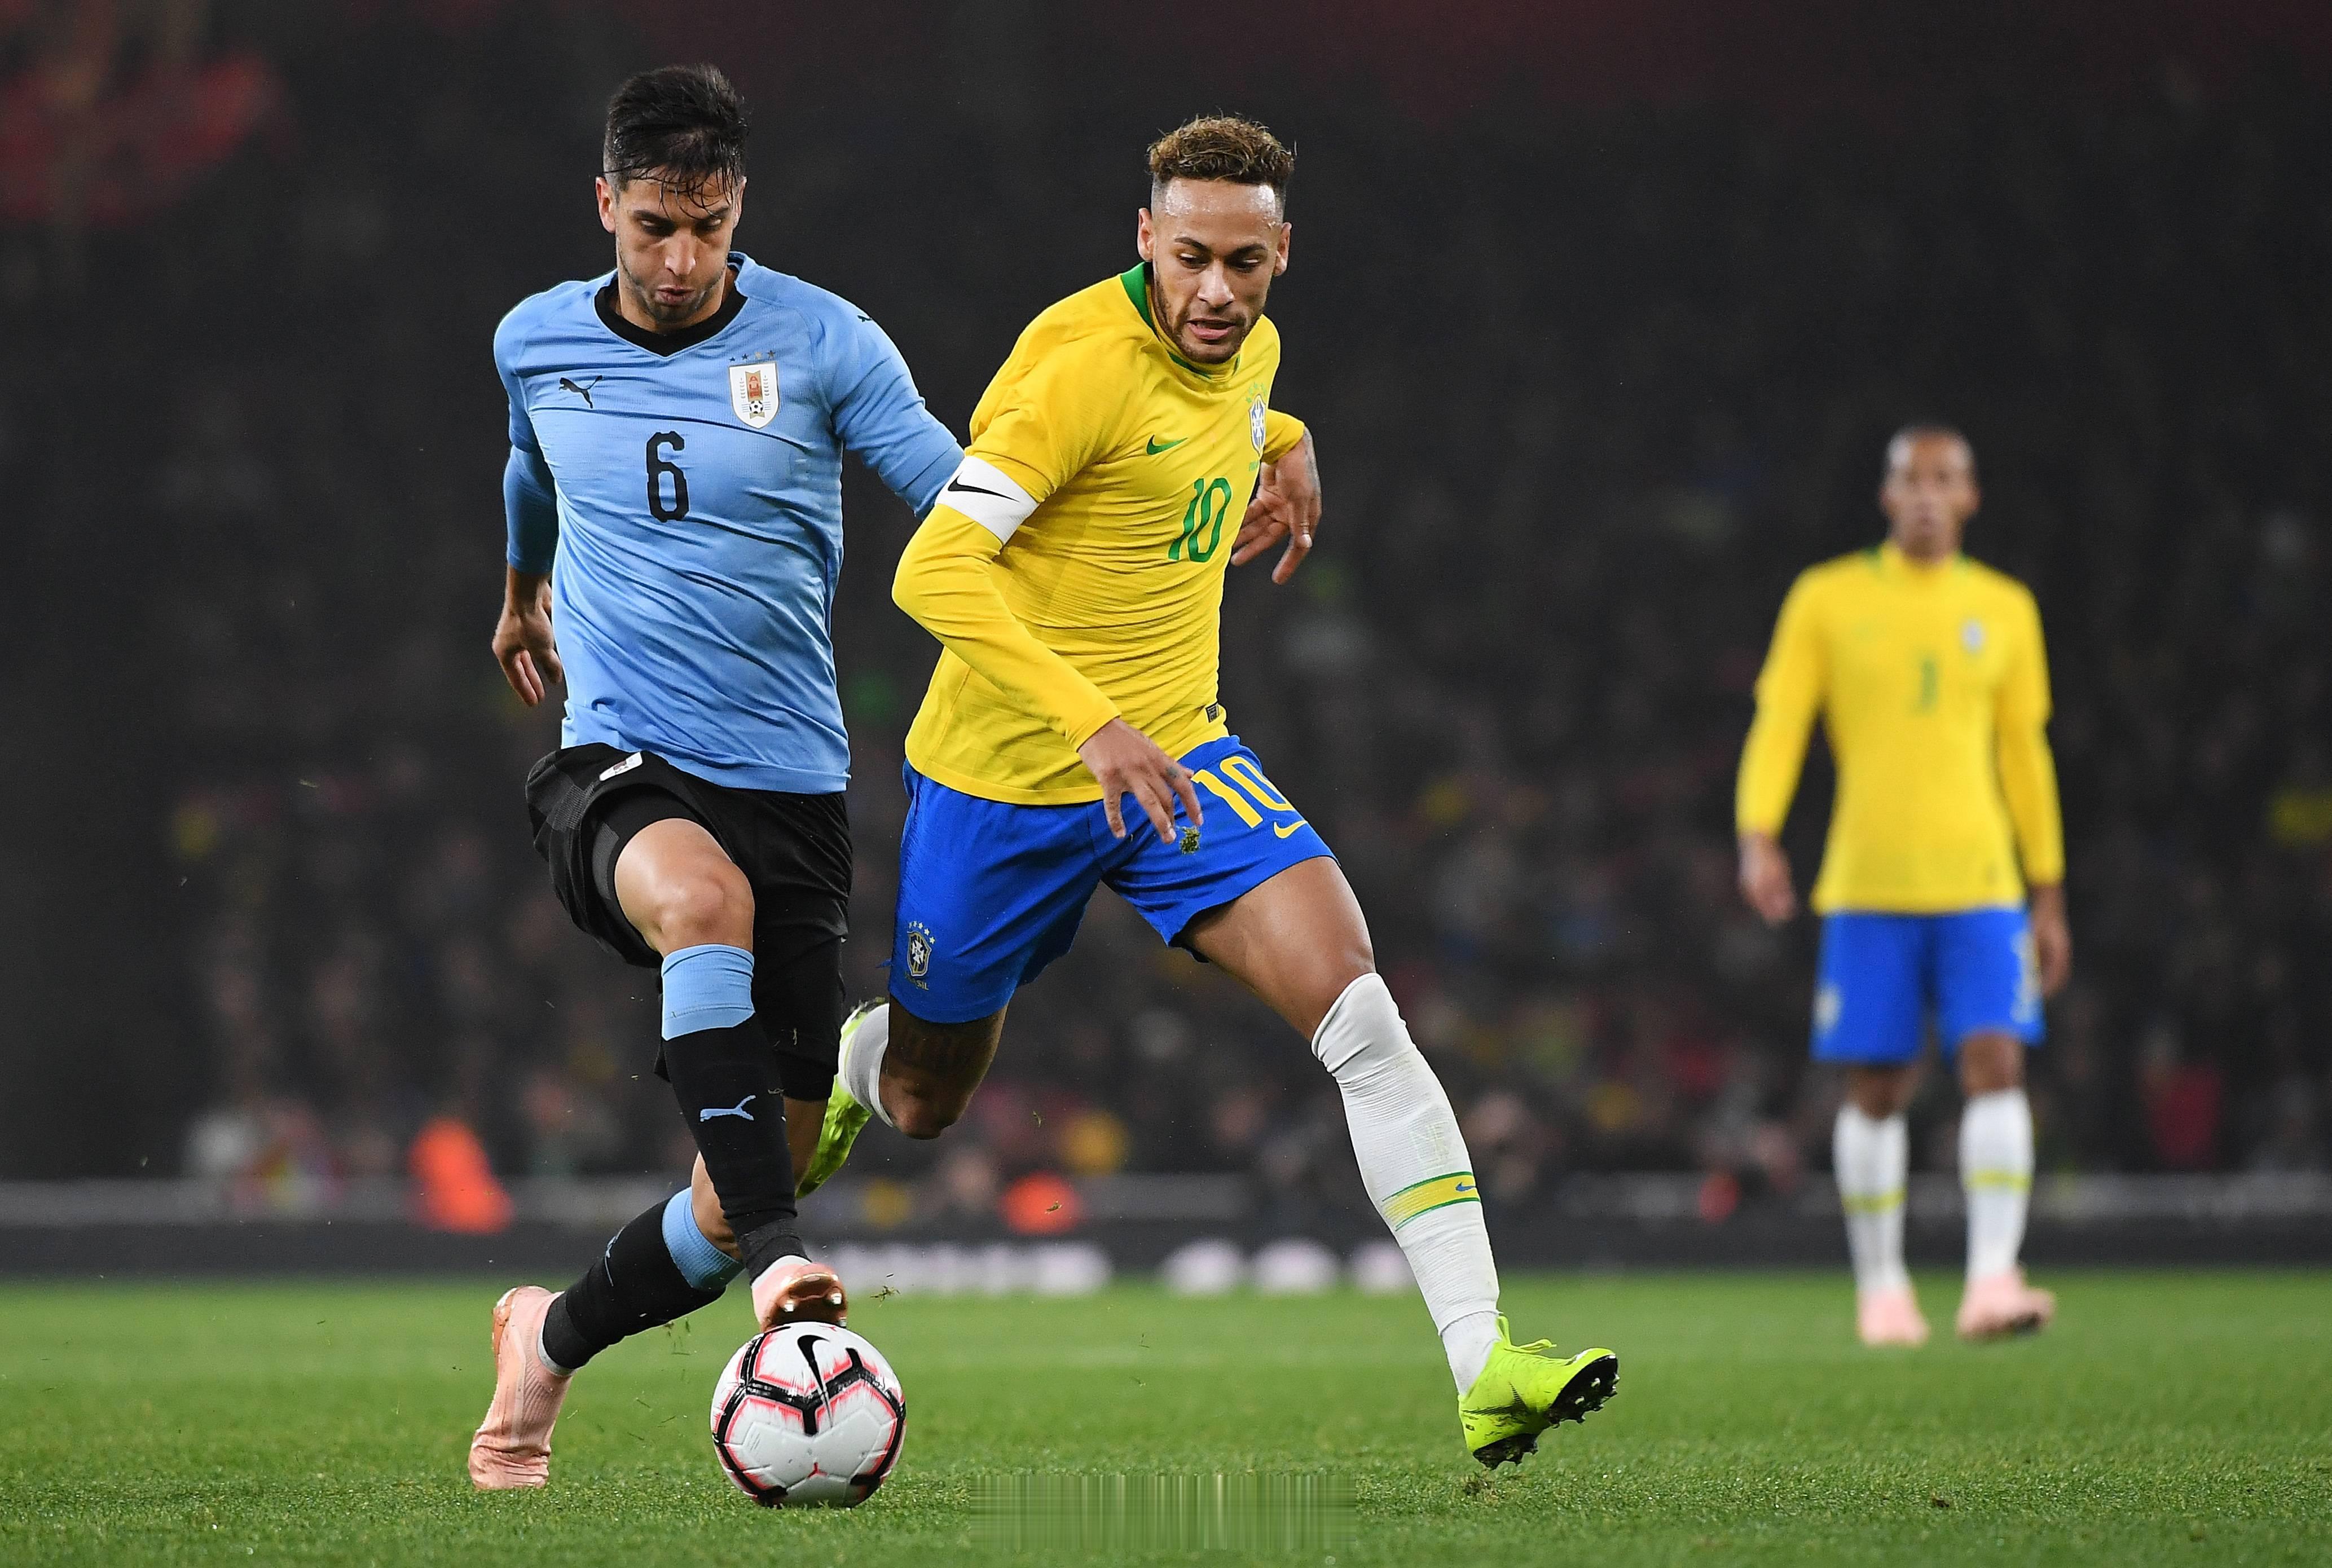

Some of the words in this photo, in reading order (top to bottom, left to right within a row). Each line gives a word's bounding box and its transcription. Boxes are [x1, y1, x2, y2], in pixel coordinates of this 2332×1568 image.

[646, 431, 689, 522] 6
[1168, 478, 1231, 562] 10
[1191, 756, 1295, 828] 10
[904, 970, 929, 990] SIL
